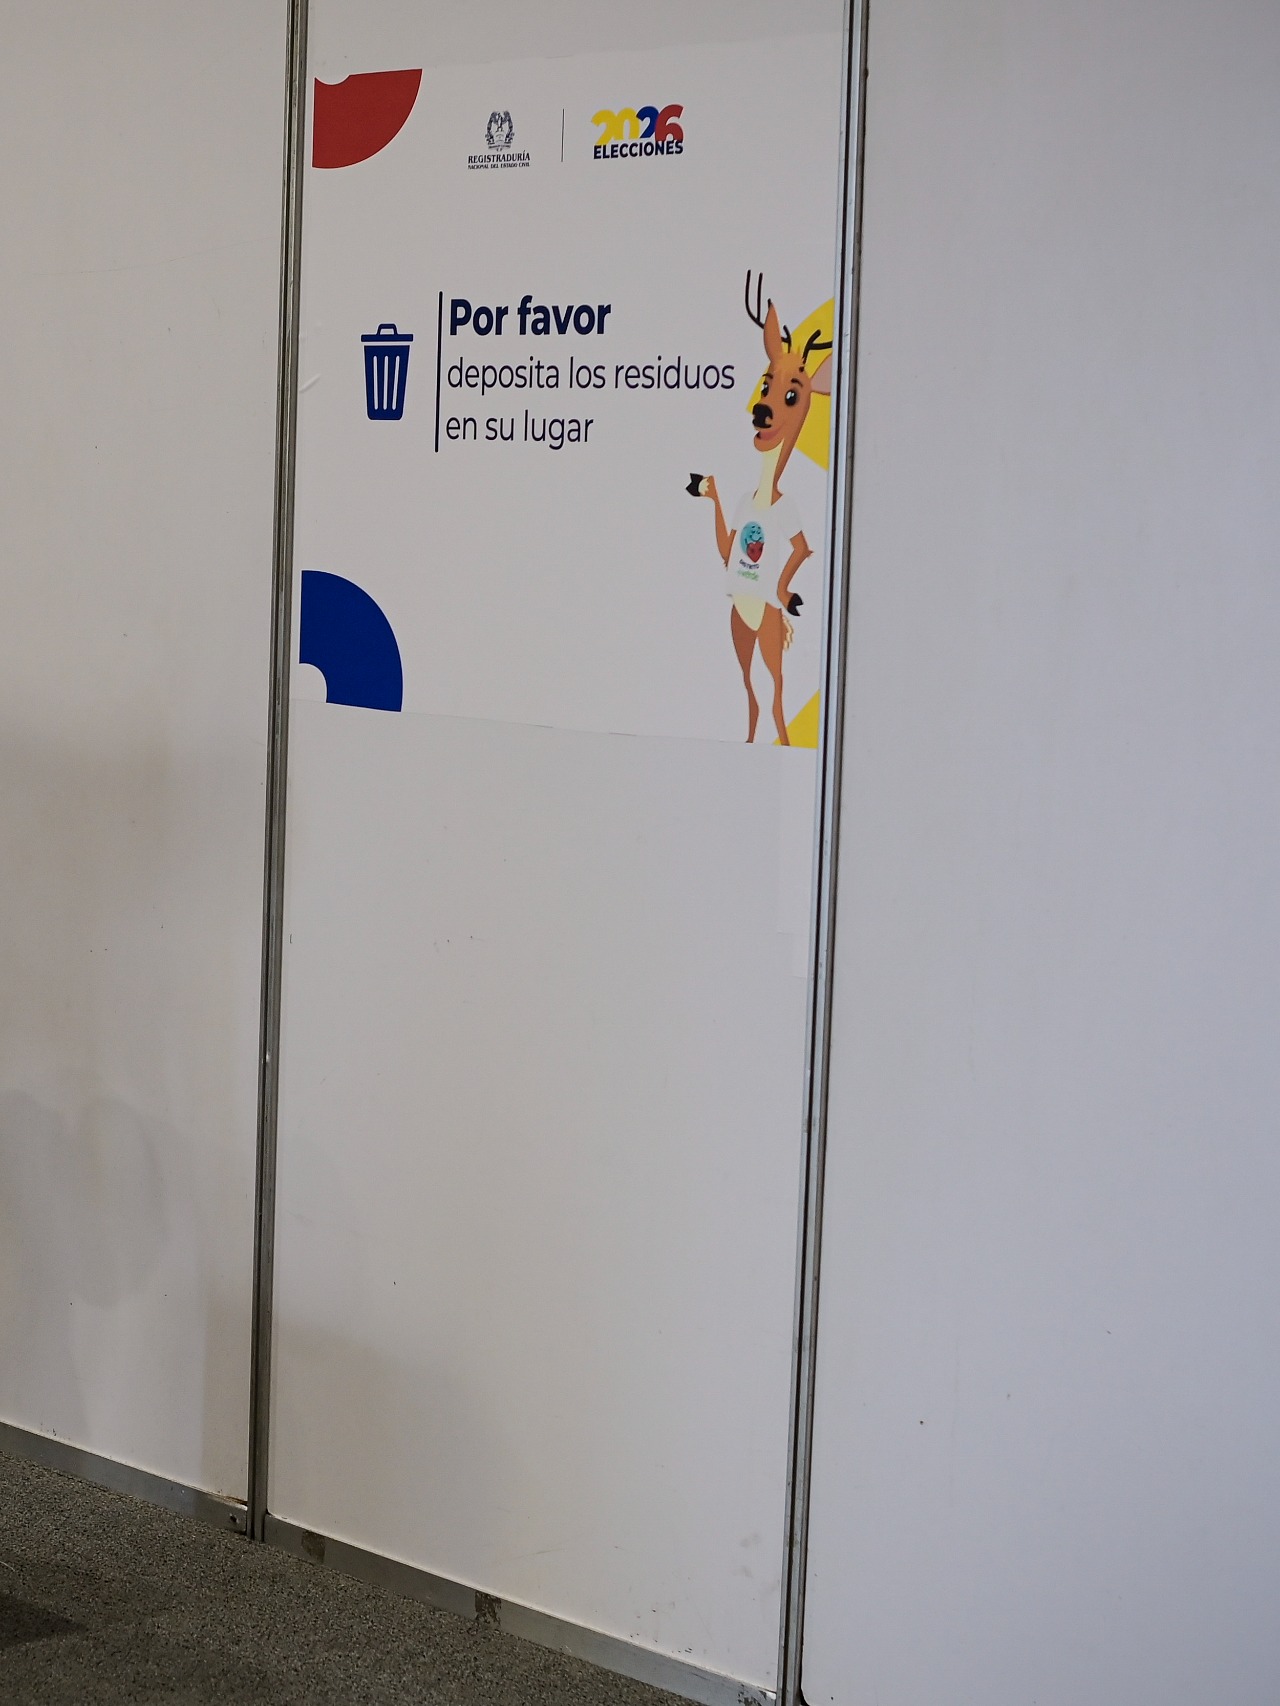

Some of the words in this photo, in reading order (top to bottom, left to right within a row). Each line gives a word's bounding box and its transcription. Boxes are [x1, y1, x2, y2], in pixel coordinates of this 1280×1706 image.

[591, 104, 684, 146] 2026
[468, 150, 530, 164] REGISTRADURÍA
[593, 139, 684, 159] ELECCIONES
[449, 298, 508, 336] Por
[518, 295, 611, 336] favor
[447, 356, 559, 396] deposita
[569, 356, 606, 389] los
[614, 355, 735, 389] residuos
[446, 414, 477, 441] en
[485, 415, 514, 442] su
[524, 410, 594, 450] lugar
